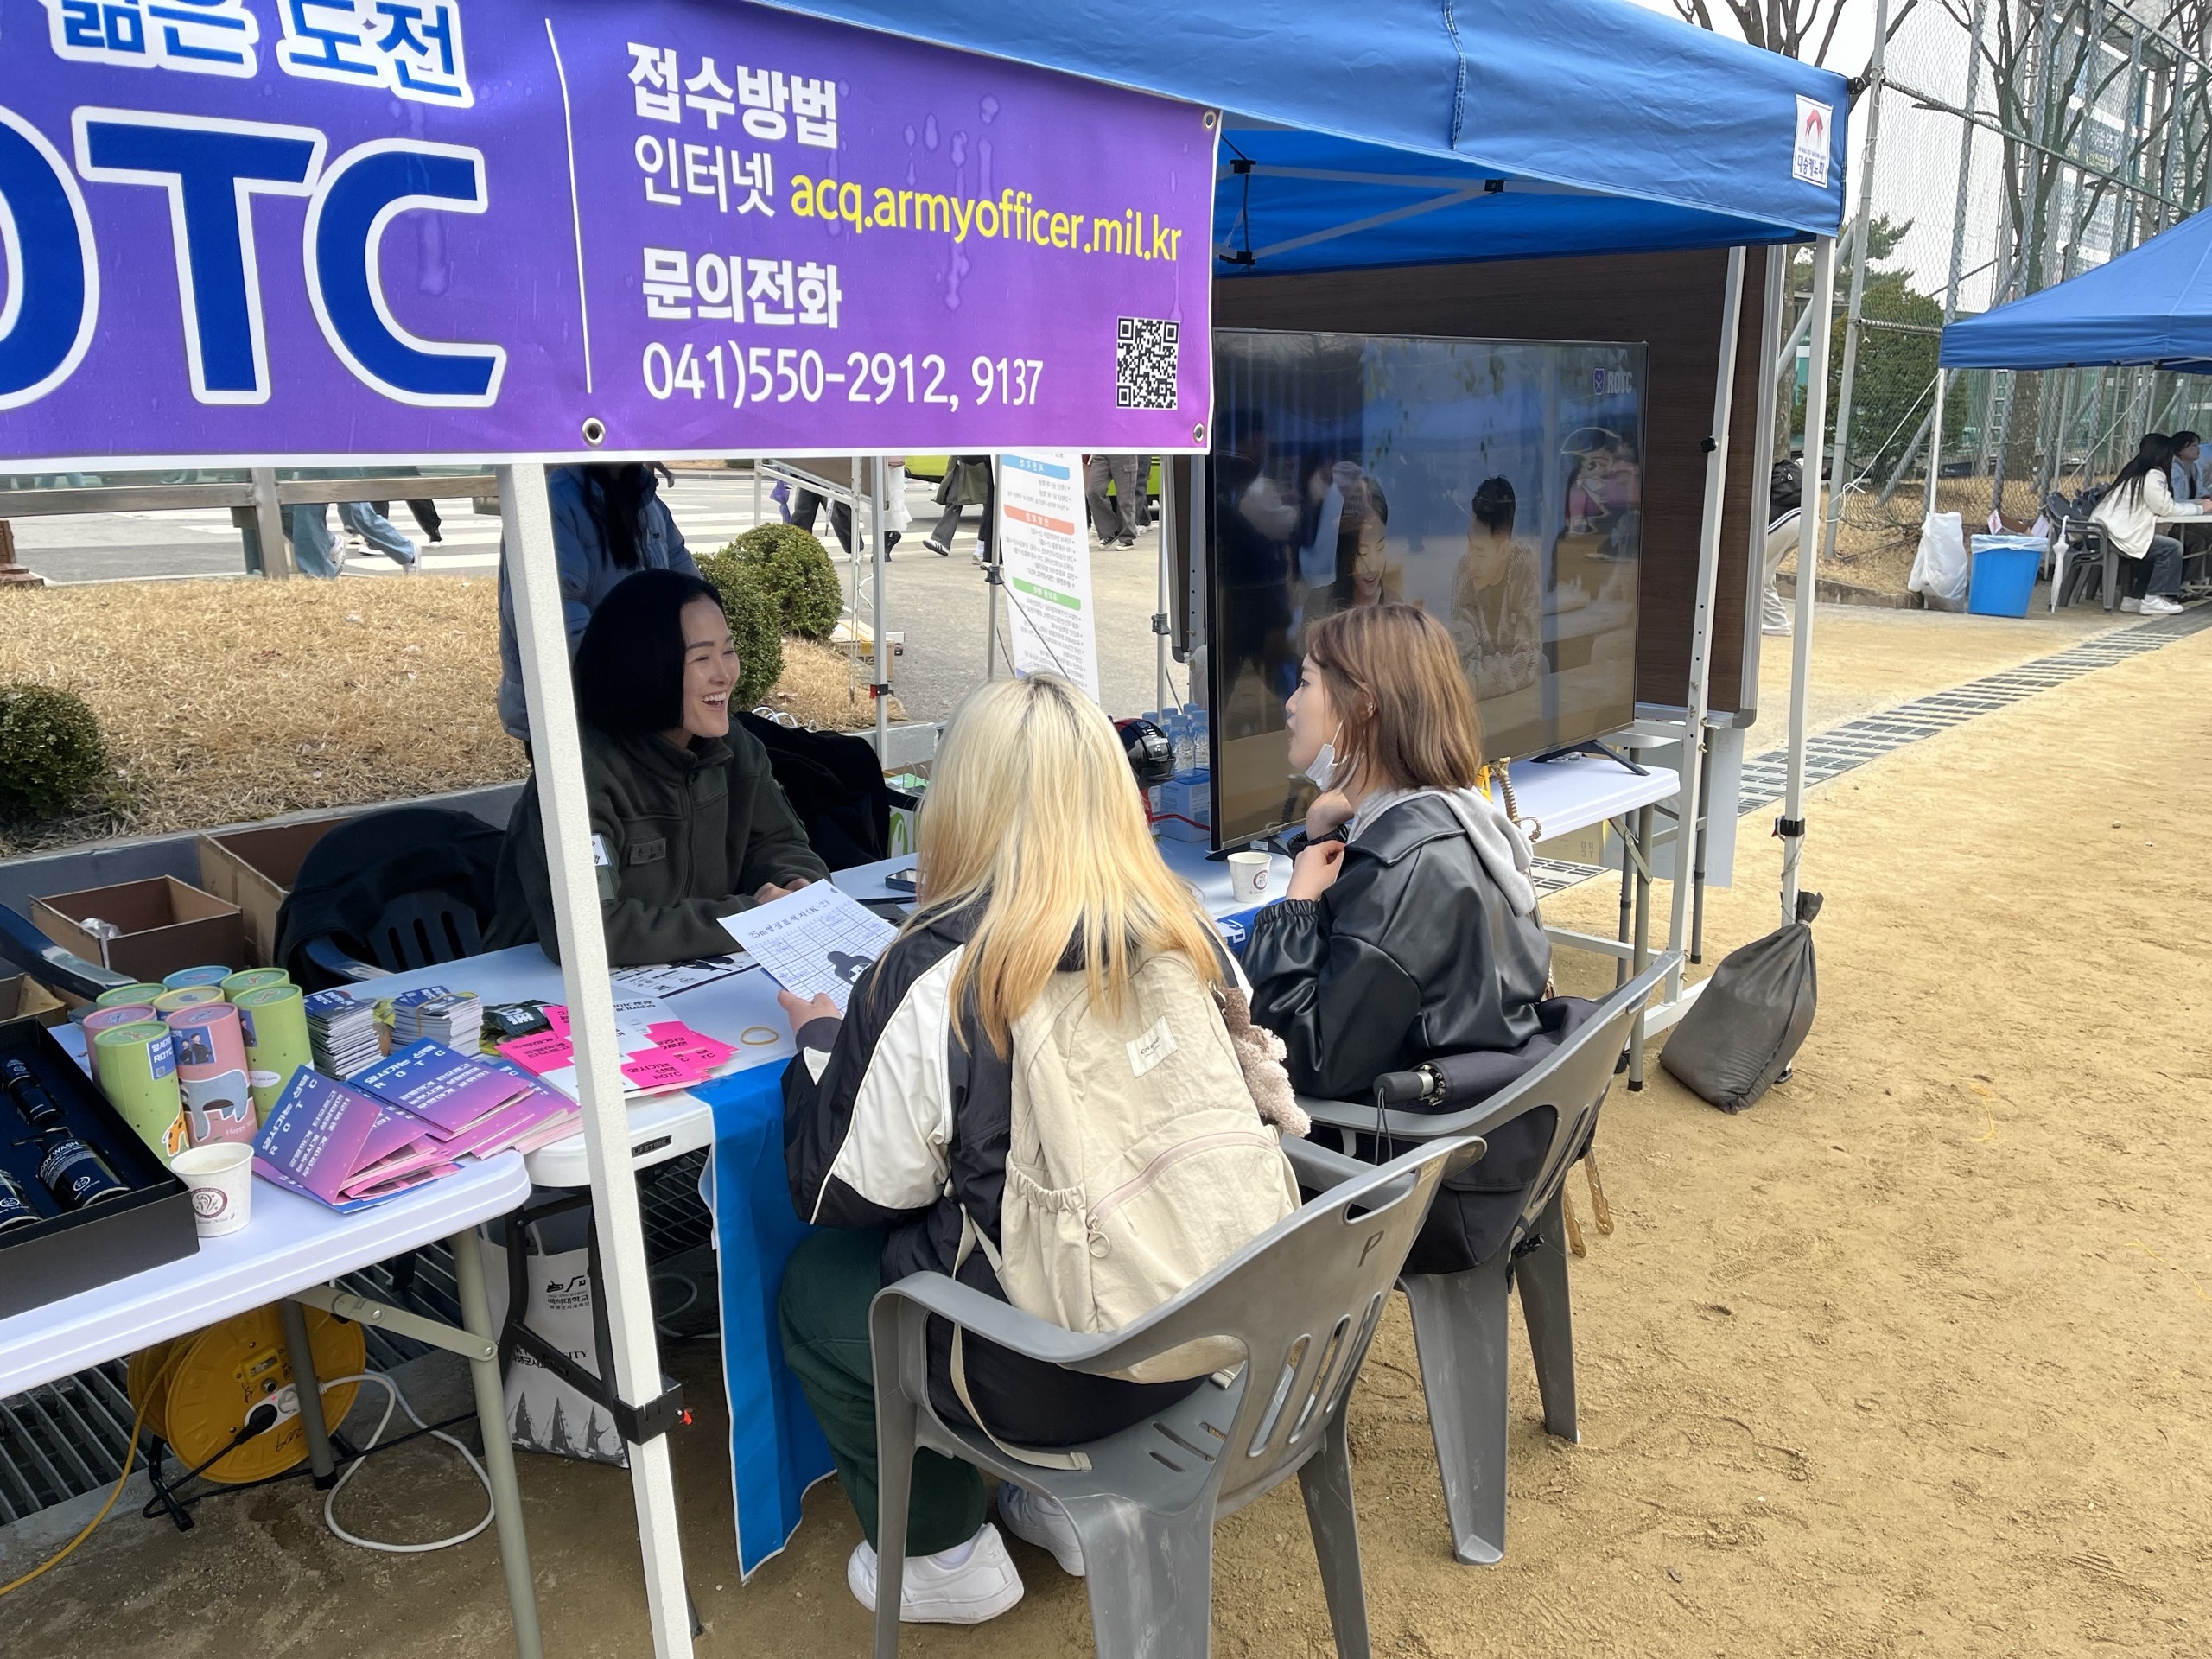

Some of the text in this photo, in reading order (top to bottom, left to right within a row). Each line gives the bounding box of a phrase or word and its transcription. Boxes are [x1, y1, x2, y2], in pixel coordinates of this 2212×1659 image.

[283, 0, 467, 102] 도전
[627, 42, 838, 149] 접수방법
[635, 135, 1182, 261] 인터넷 acq.armyofficer.mil.kr
[642, 248, 841, 328] 문의전화
[642, 340, 1043, 412] 041)550-2912, 9137
[1607, 371, 1632, 394] ROTC
[52, 1141, 79, 1155] WASH
[1357, 1230, 1384, 1268] P
[548, 1294, 588, 1305] 백석대학교
